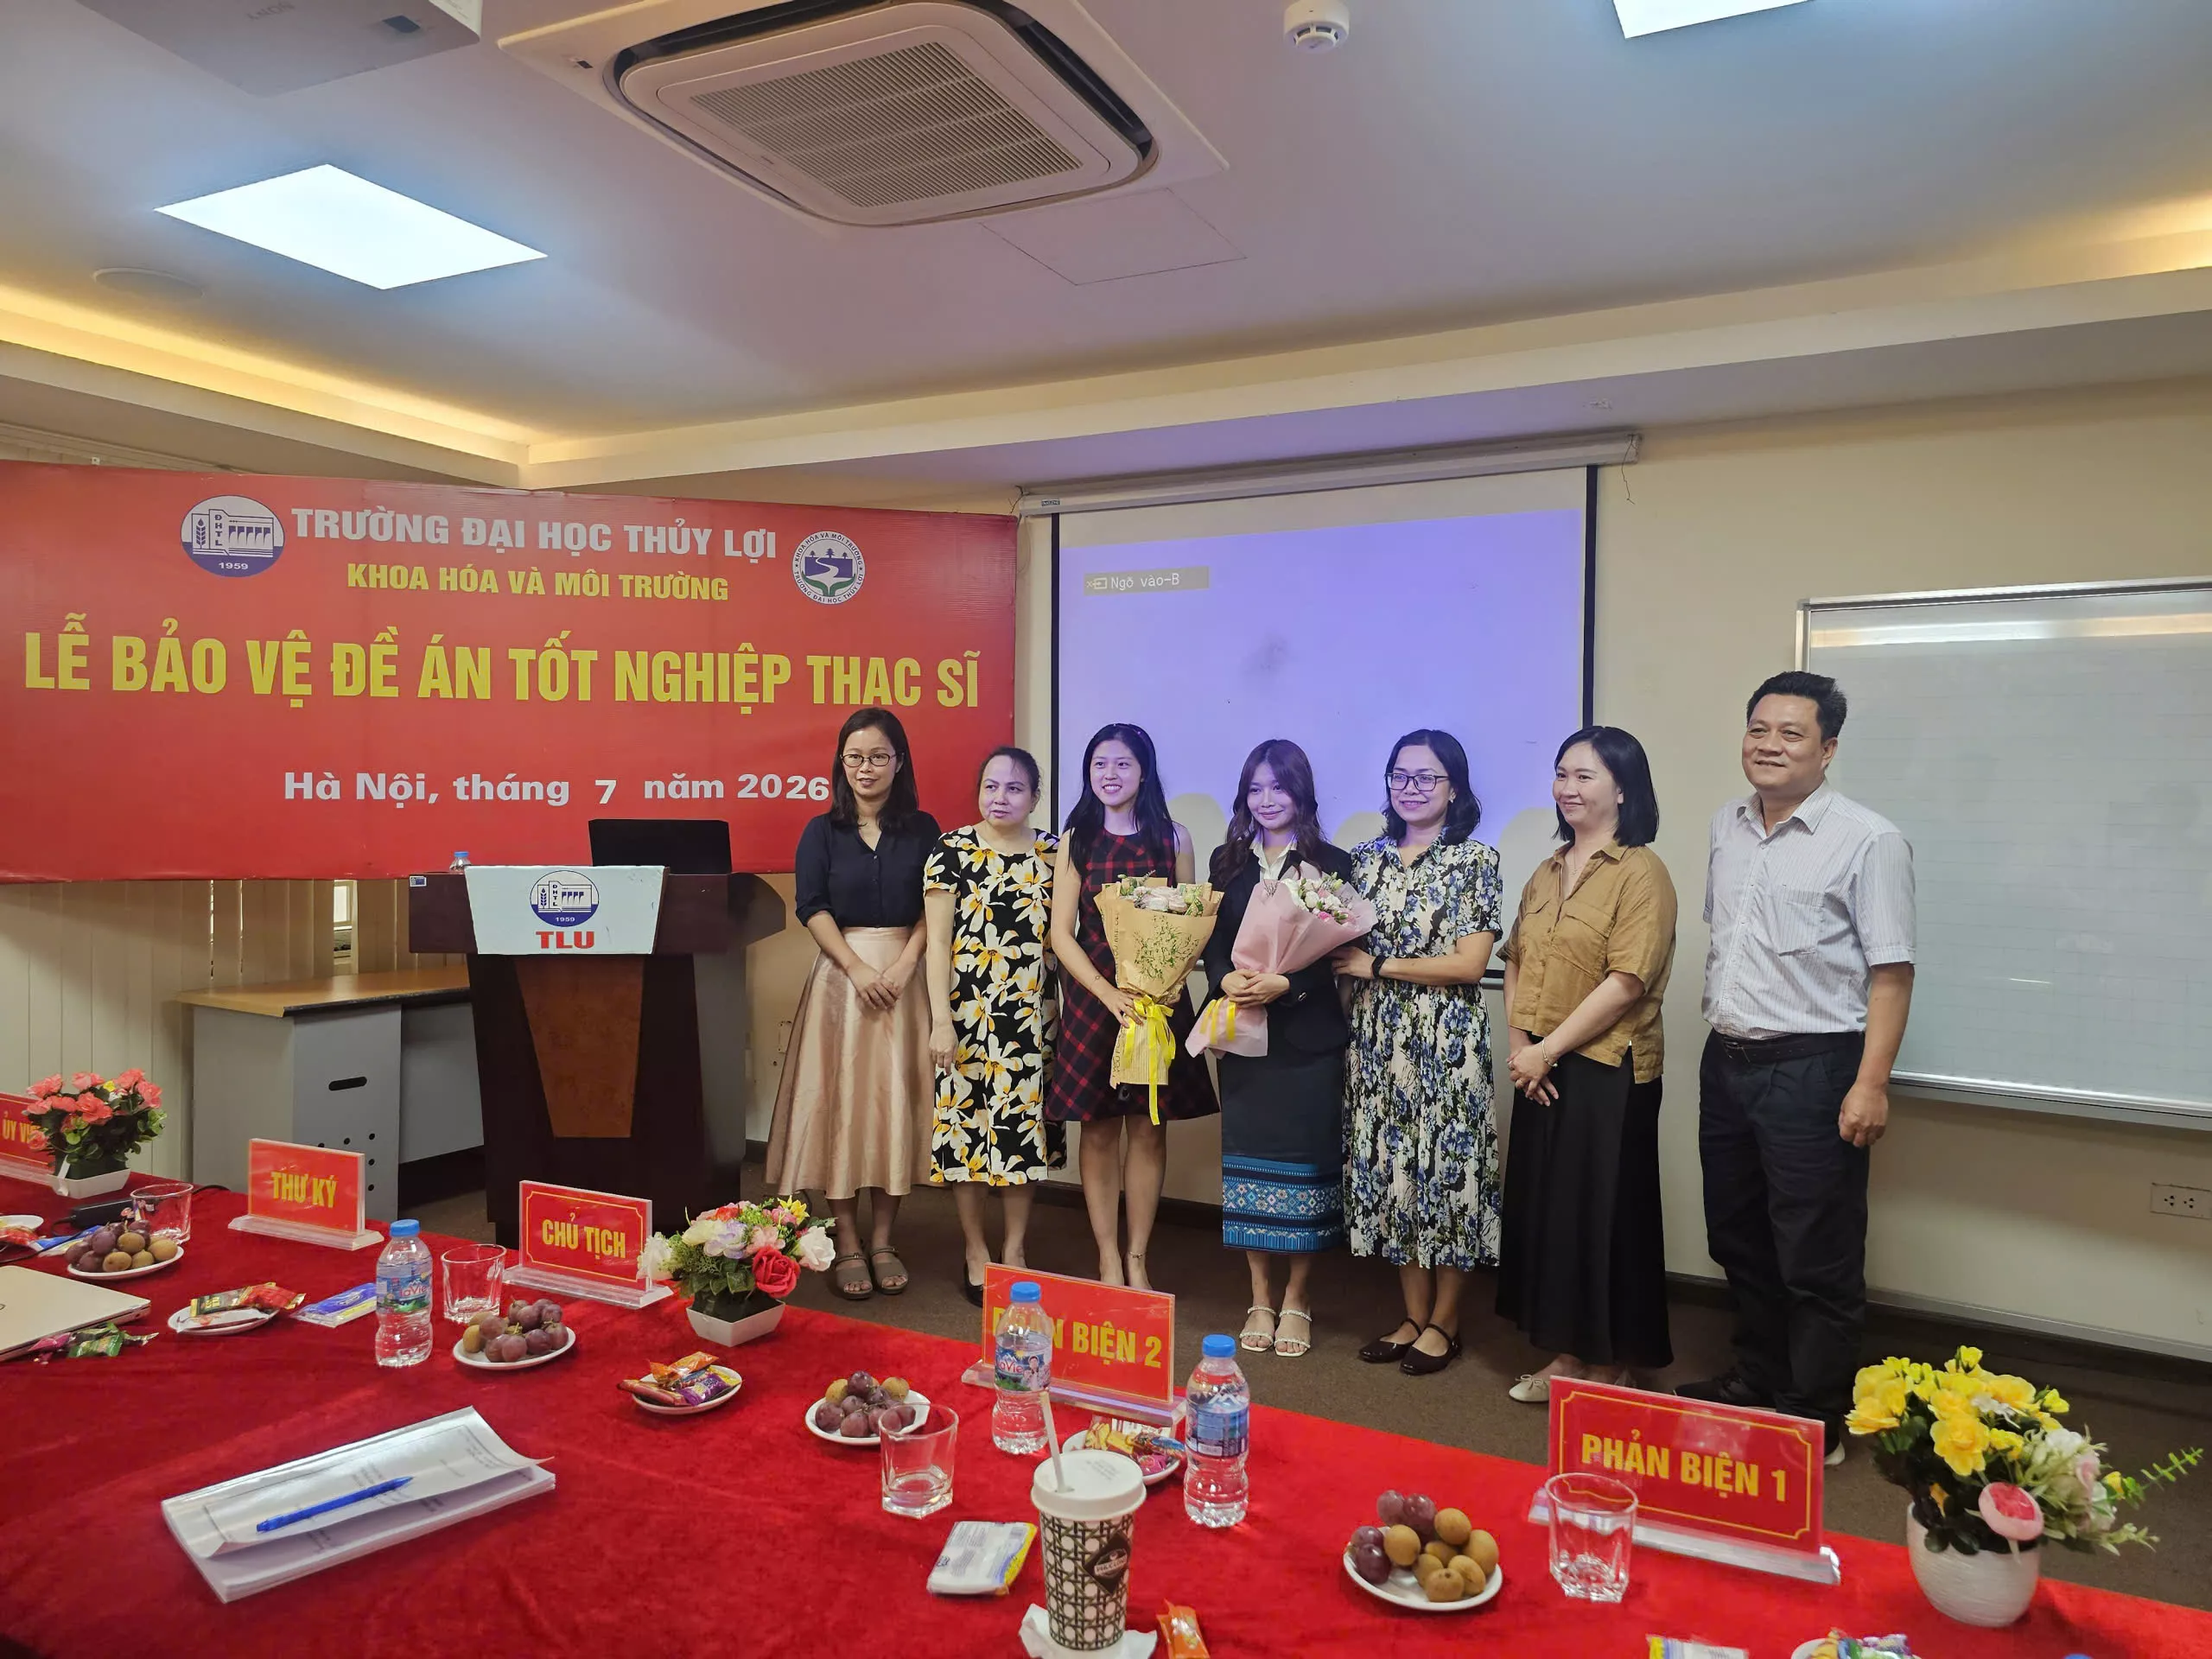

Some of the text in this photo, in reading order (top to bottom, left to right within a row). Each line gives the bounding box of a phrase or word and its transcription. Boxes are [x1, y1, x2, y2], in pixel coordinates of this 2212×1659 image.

[291, 505, 776, 564] TRƯỜNG ĐẠI HỌC THỦY LỢI
[347, 563, 728, 601] KHOA HÓA VÀ MÔI TRƯỜNG
[1141, 573, 1179, 588] vào-B
[25, 612, 90, 690] LỄ
[112, 617, 226, 694] BẢO
[245, 629, 312, 708] VỆ
[330, 626, 399, 697] ĐỀ
[417, 633, 491, 700] ÁN
[508, 630, 598, 702] TỐT
[614, 642, 791, 715] NGHIỆP
[937, 650, 981, 708] SĨ
[284, 772, 830, 809] Hà Nội, tháng 7 năm 2026
[536, 931, 594, 949] TLU
[271, 1172, 336, 1208] THƯ KÝ
[542, 1212, 626, 1260] CHỦ TỊCH
[1072, 1320, 1136, 1365] BIỆN
[1145, 1336, 1162, 1369] 2
[1581, 1428, 1786, 1502] PHẢN BIỆN 1
